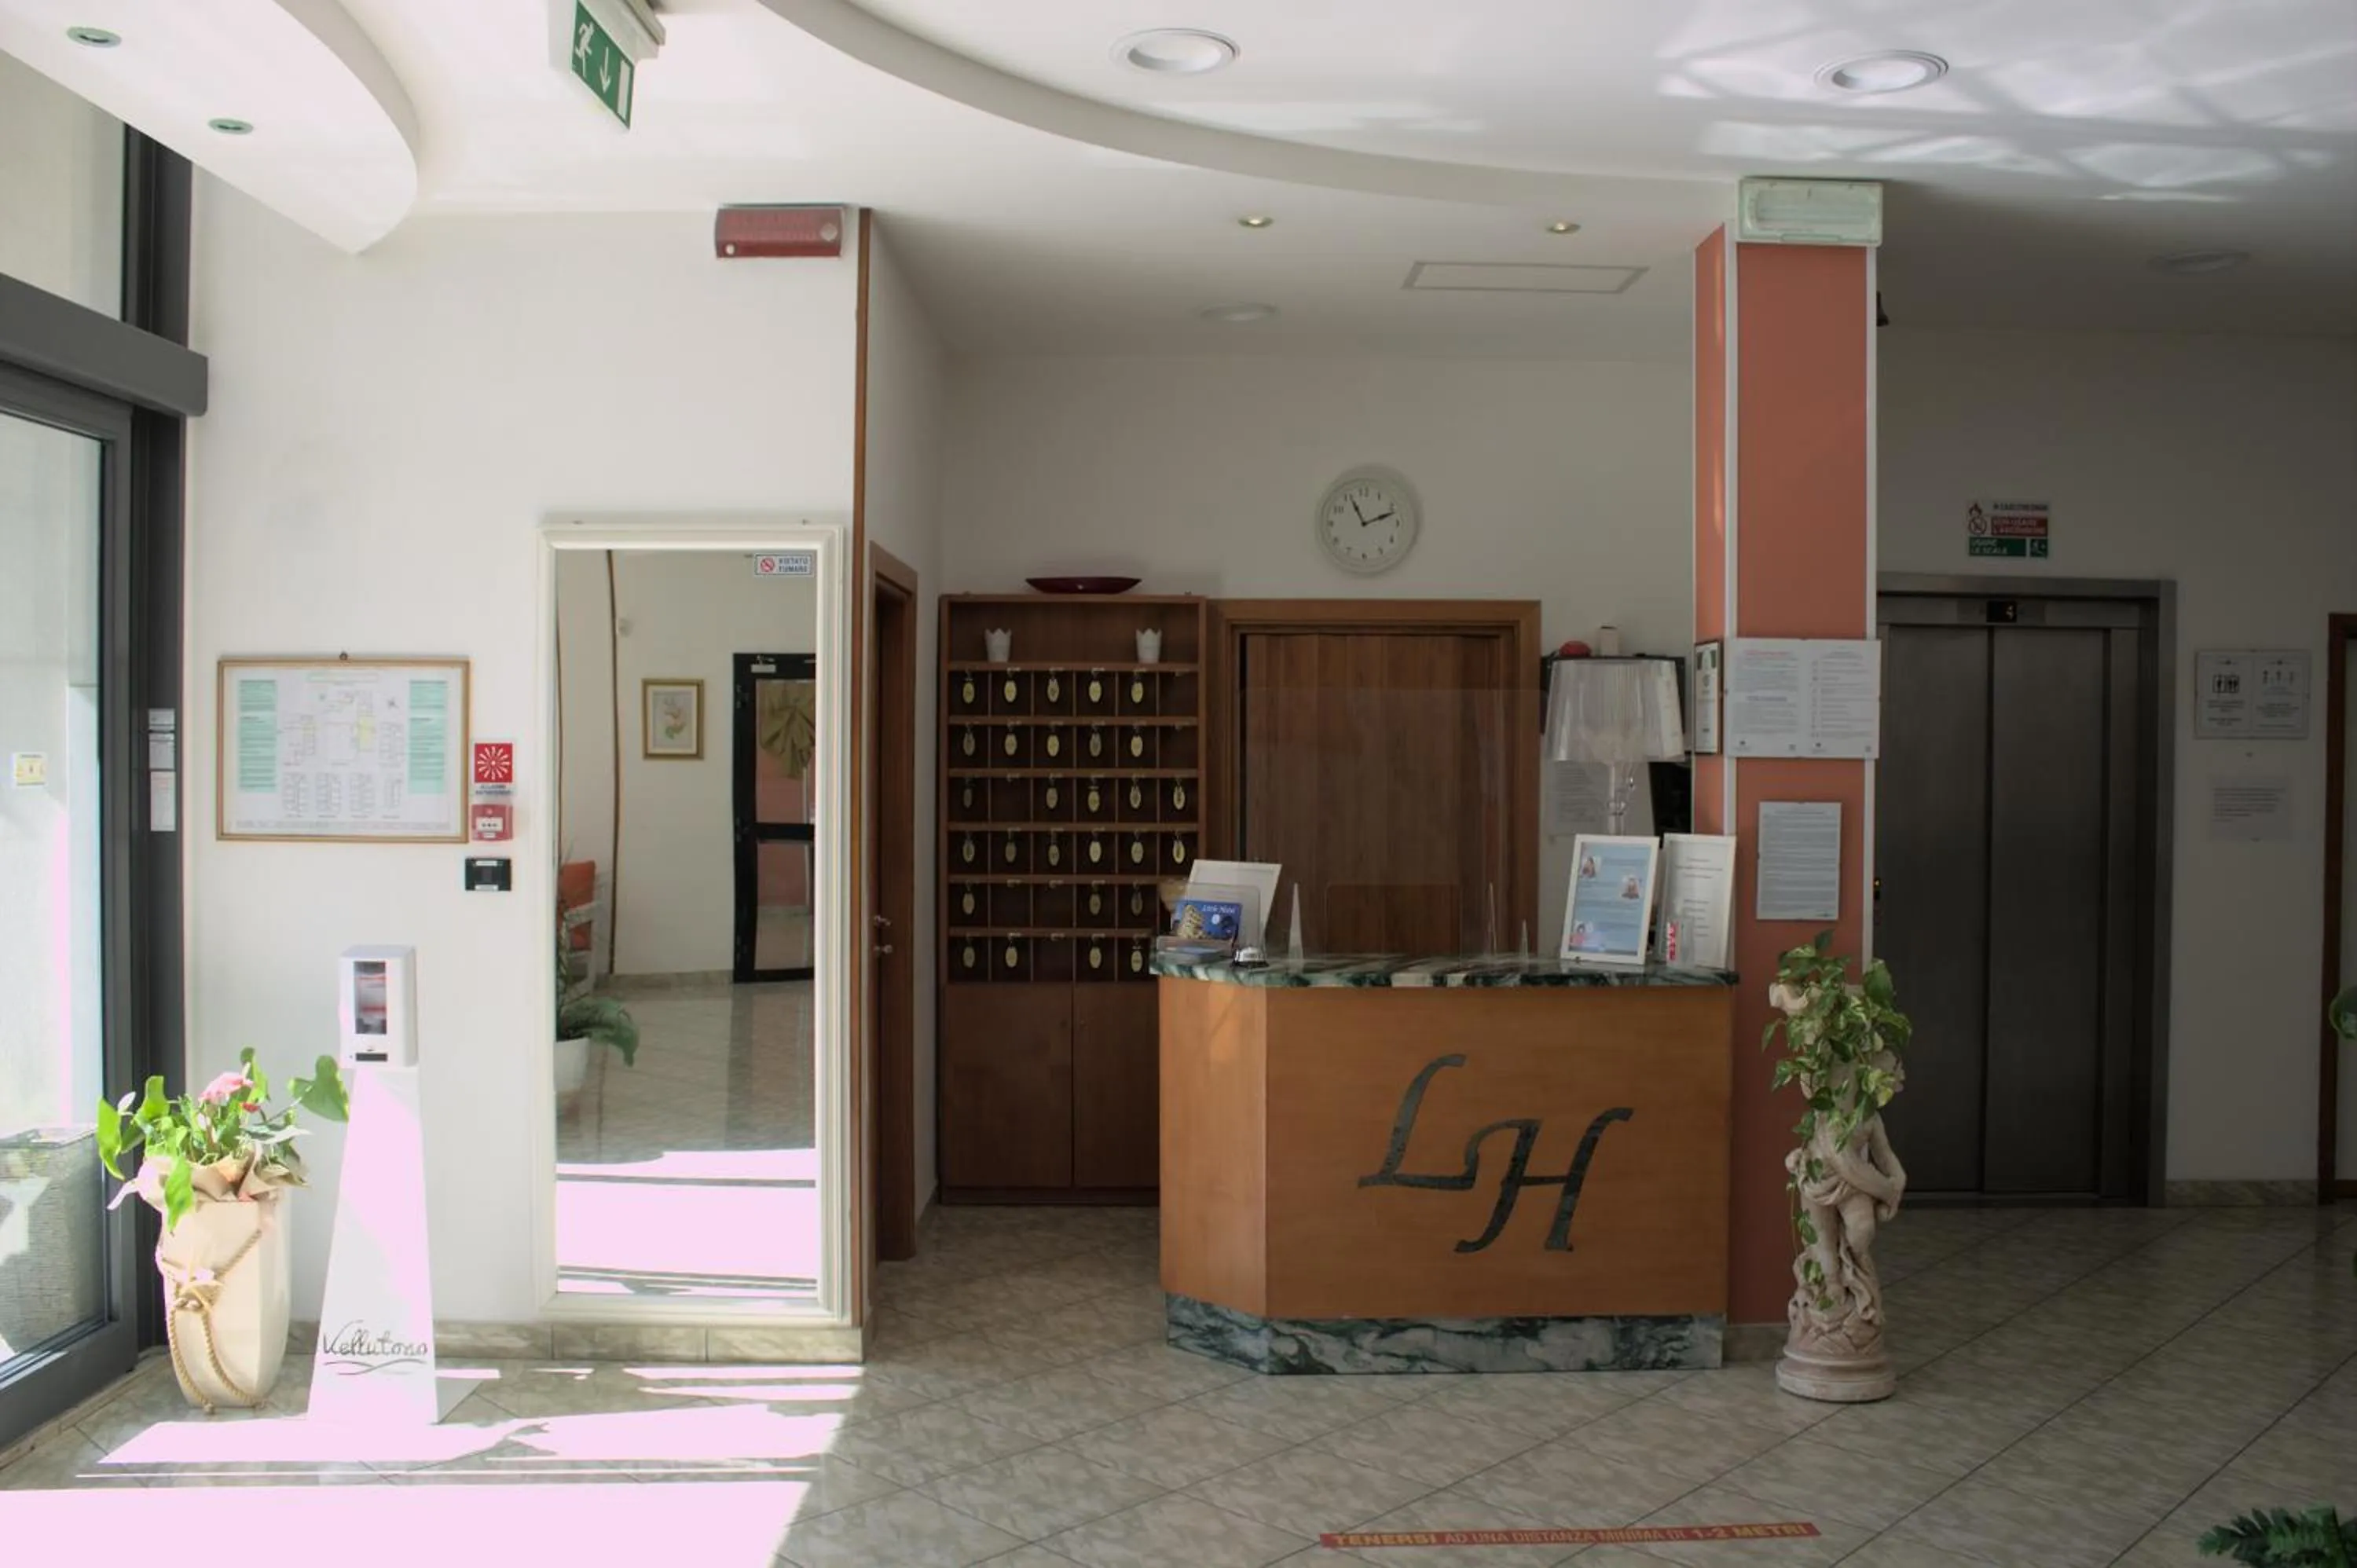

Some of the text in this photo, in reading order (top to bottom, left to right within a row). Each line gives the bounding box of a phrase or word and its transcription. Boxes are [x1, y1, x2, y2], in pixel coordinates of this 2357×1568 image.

[1334, 1533, 1437, 1546] TENERSI
[1445, 1533, 1468, 1544] AD
[1473, 1532, 1509, 1543] UNA
[1513, 1531, 1600, 1543] DISTANZA
[1732, 1524, 1809, 1537] METRI
